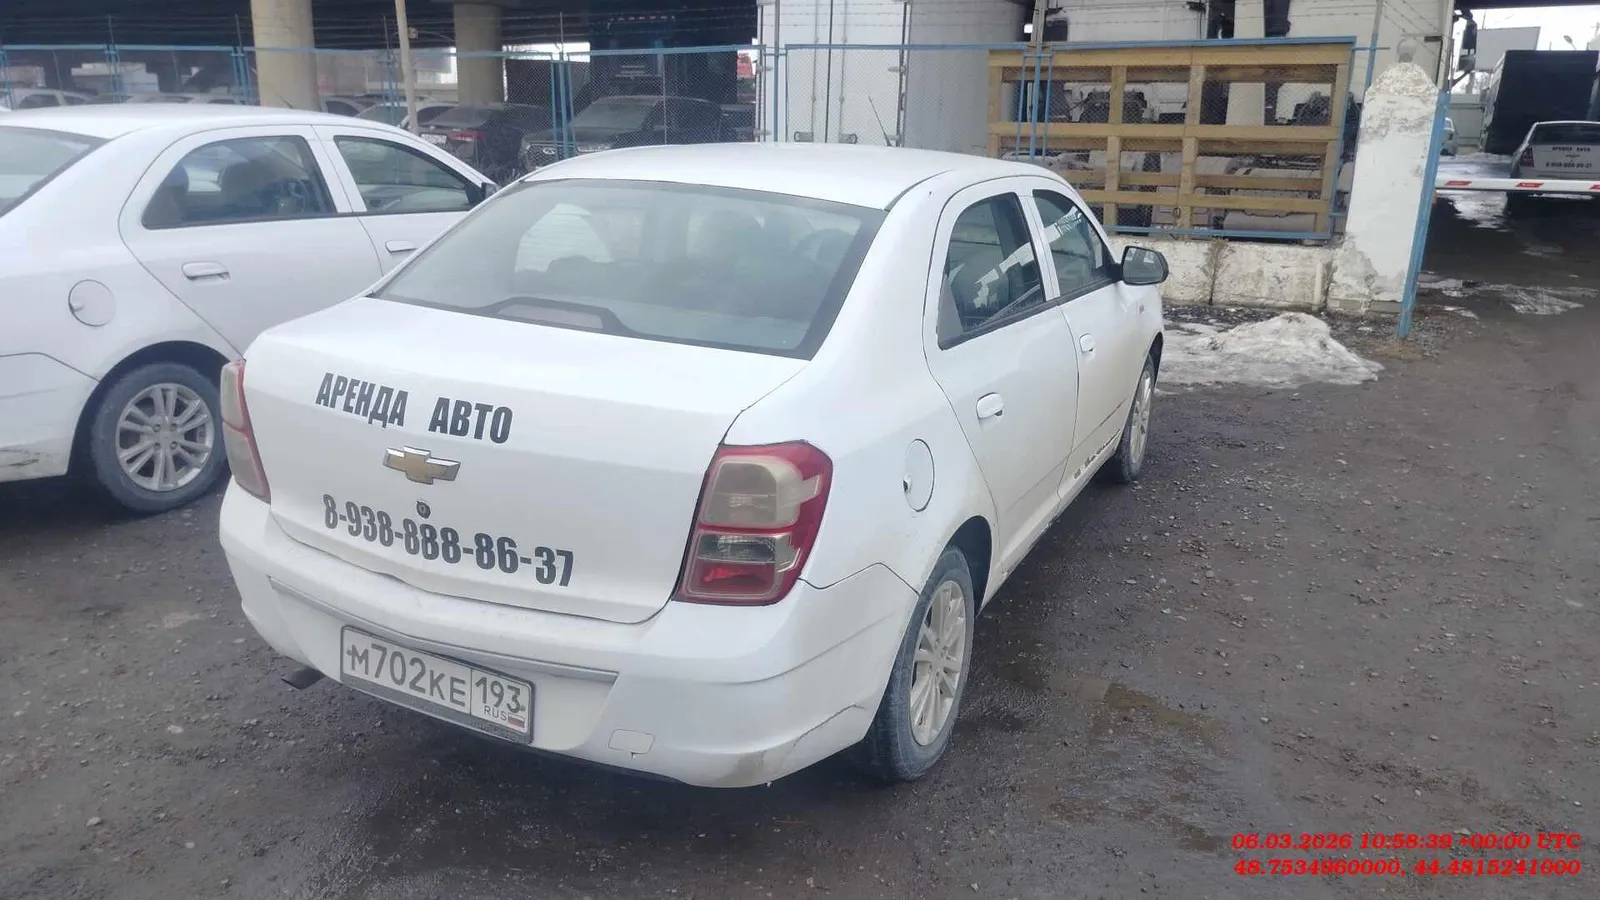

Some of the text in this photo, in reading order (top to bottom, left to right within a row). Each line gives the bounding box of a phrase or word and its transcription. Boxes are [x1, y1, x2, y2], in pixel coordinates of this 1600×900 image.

[315, 372, 513, 444] АРЕНДА АВТО
[323, 494, 575, 587] 8-938-888-86-37
[475, 676, 522, 714] 193
[484, 705, 508, 721] RUS
